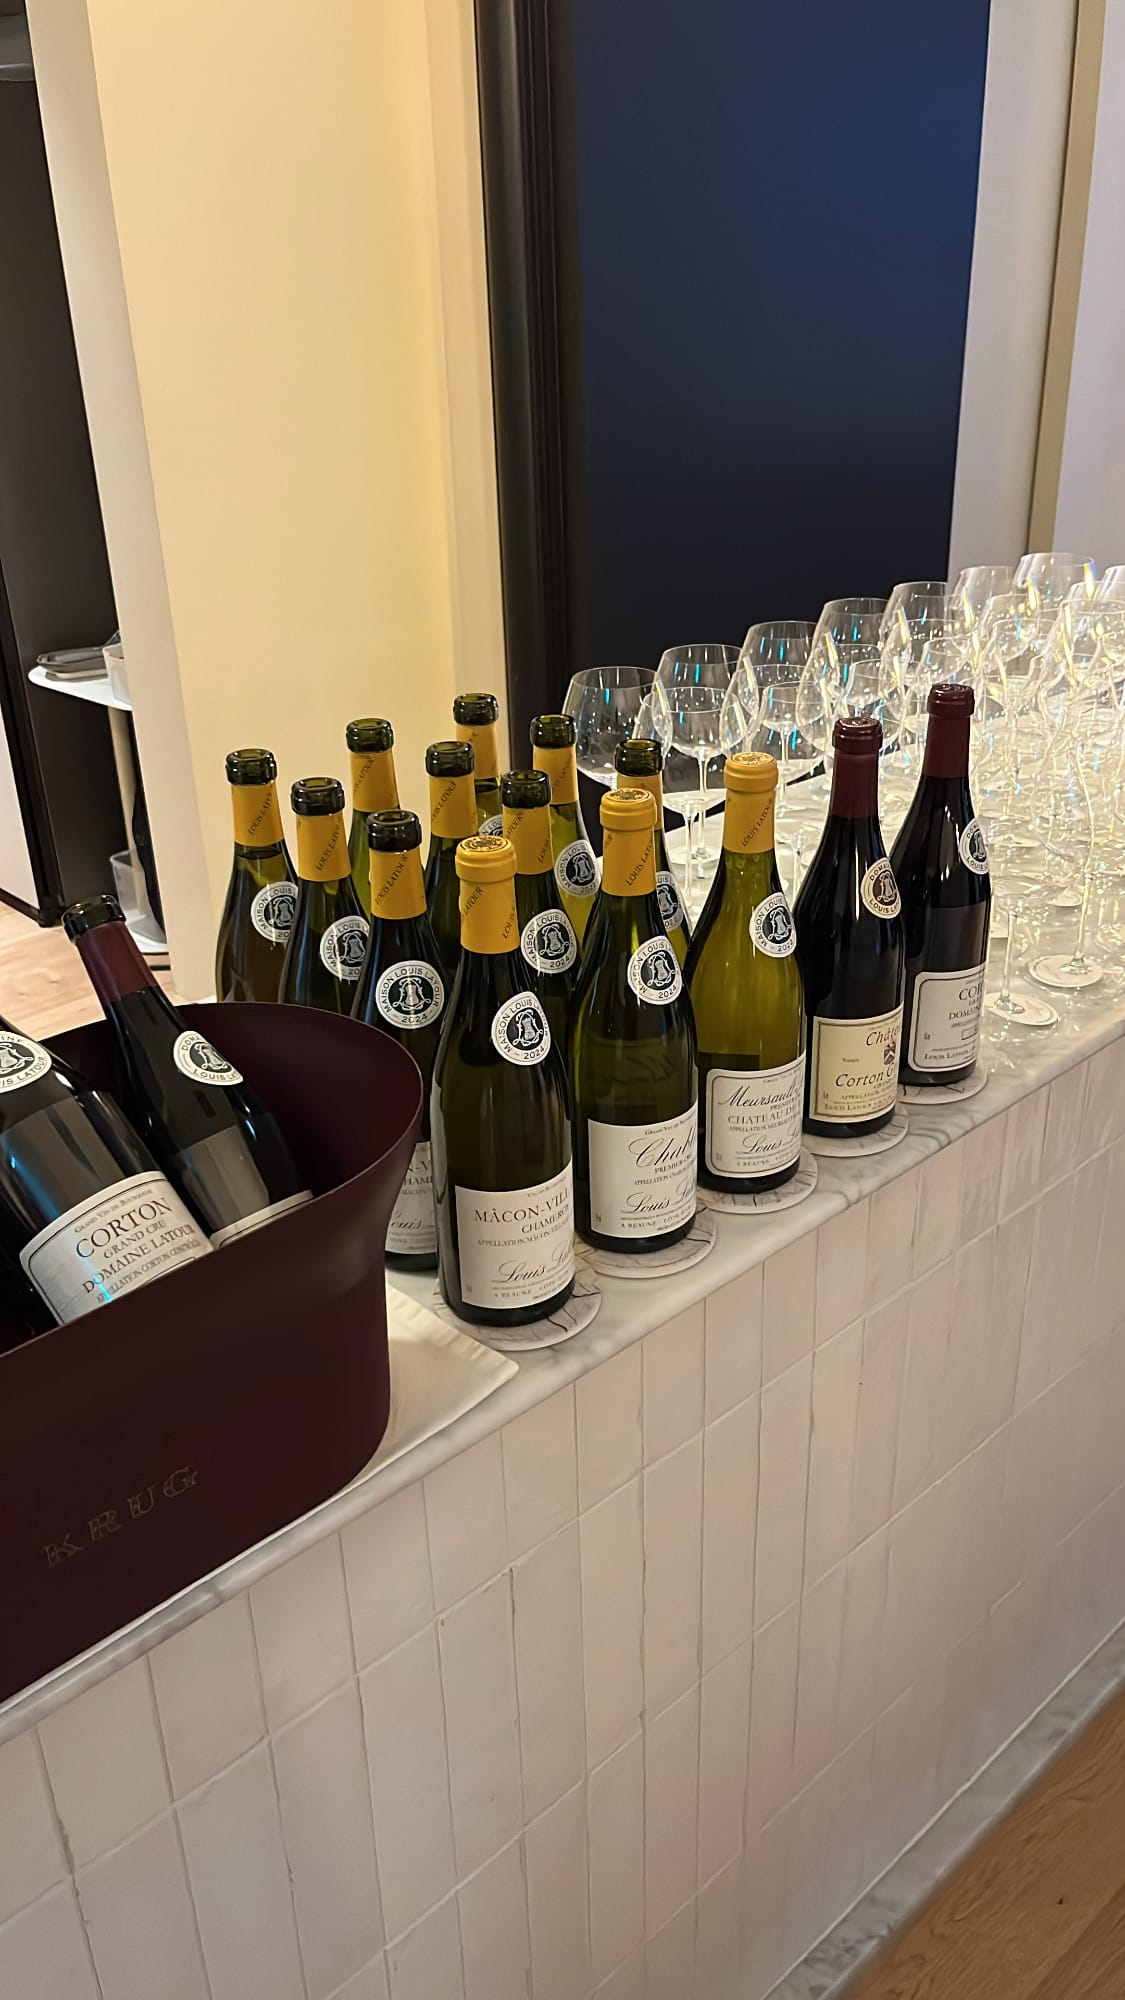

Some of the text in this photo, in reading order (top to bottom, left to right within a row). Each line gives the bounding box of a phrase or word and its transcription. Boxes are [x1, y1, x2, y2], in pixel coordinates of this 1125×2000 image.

[742, 824, 759, 847] LOUIS
[316, 849, 331, 871] LOUIS
[387, 853, 409, 887] LATOUR
[967, 857, 984, 870] LOUIS
[560, 857, 571, 888] MAISON
[625, 863, 644, 887] LOUIS
[257, 887, 293, 931] MAISON LOUIS
[870, 899, 889, 914] LOUIS
[277, 930, 290, 938] 20
[338, 921, 361, 935] LOUIS
[756, 898, 783, 948] MAISON LOUIS
[526, 928, 538, 962] MAISON
[537, 914, 560, 928] LOUIS
[643, 942, 665, 957] LOUIS
[348, 968, 361, 976] 20
[550, 955, 571, 968] 2024
[381, 967, 440, 1013] MAISON LOUIS LATOUR
[658, 986, 677, 999] 2024
[959, 982, 982, 1000] COR
[401, 1013, 428, 1024] 2024
[949, 1005, 981, 1020] DOMAIN
[498, 1013, 513, 1053] MAISON
[510, 999, 533, 1014] LOUIS
[523, 1046, 545, 1060] 2024
[193, 1068, 226, 1081] LOUIS
[835, 1071, 884, 1087] Corton
[736, 1133, 782, 1155] Louis
[620, 1191, 670, 1214] Louis
[76, 1197, 173, 1258] CORTON
[391, 1219, 422, 1229] ouis
[103, 1220, 167, 1259] GRAND CRU
[82, 1244, 152, 1293] DOMAINE
[492, 1259, 546, 1283] Louis
[42, 1466, 198, 1568] KRUG
